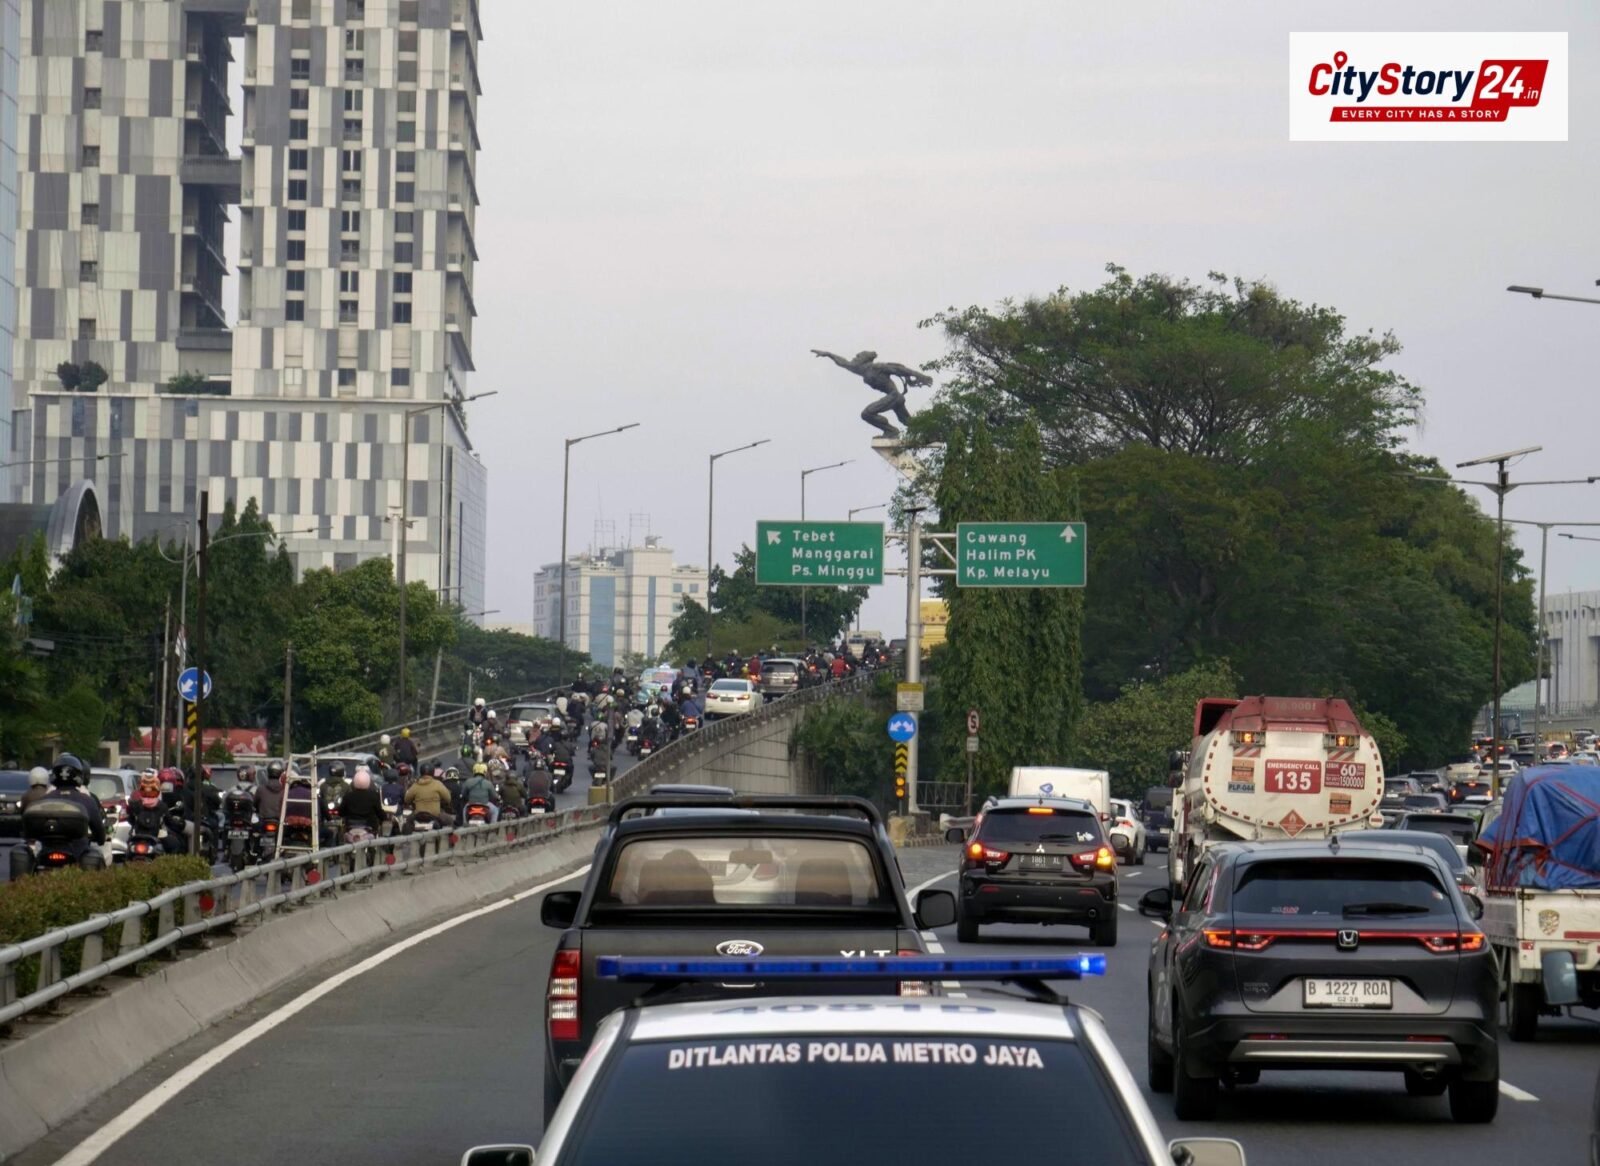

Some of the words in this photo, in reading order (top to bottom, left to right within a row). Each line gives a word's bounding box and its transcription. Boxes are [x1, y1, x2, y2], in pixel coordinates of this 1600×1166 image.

[792, 530, 835, 542] Tebet
[966, 531, 1027, 546] Cawang
[792, 547, 873, 562] Manggarai
[966, 549, 1011, 561] Halim
[1016, 549, 1036, 561] PK
[792, 564, 813, 576] Ps.
[818, 564, 874, 580] Minggu
[966, 566, 988, 580] Kp.
[994, 566, 1049, 580] Melayu
[1340, 763, 1357, 777] 60
[1274, 771, 1312, 791] 135
[726, 943, 753, 955] Ford
[1308, 981, 1317, 996] B
[1325, 981, 1358, 996] 1227
[1363, 981, 1388, 996] ROA
[668, 1042, 801, 1069] DITLANTAS
[807, 1042, 887, 1064] POLDA
[893, 1042, 977, 1064] METRO
[983, 1045, 1044, 1068] JAYA
